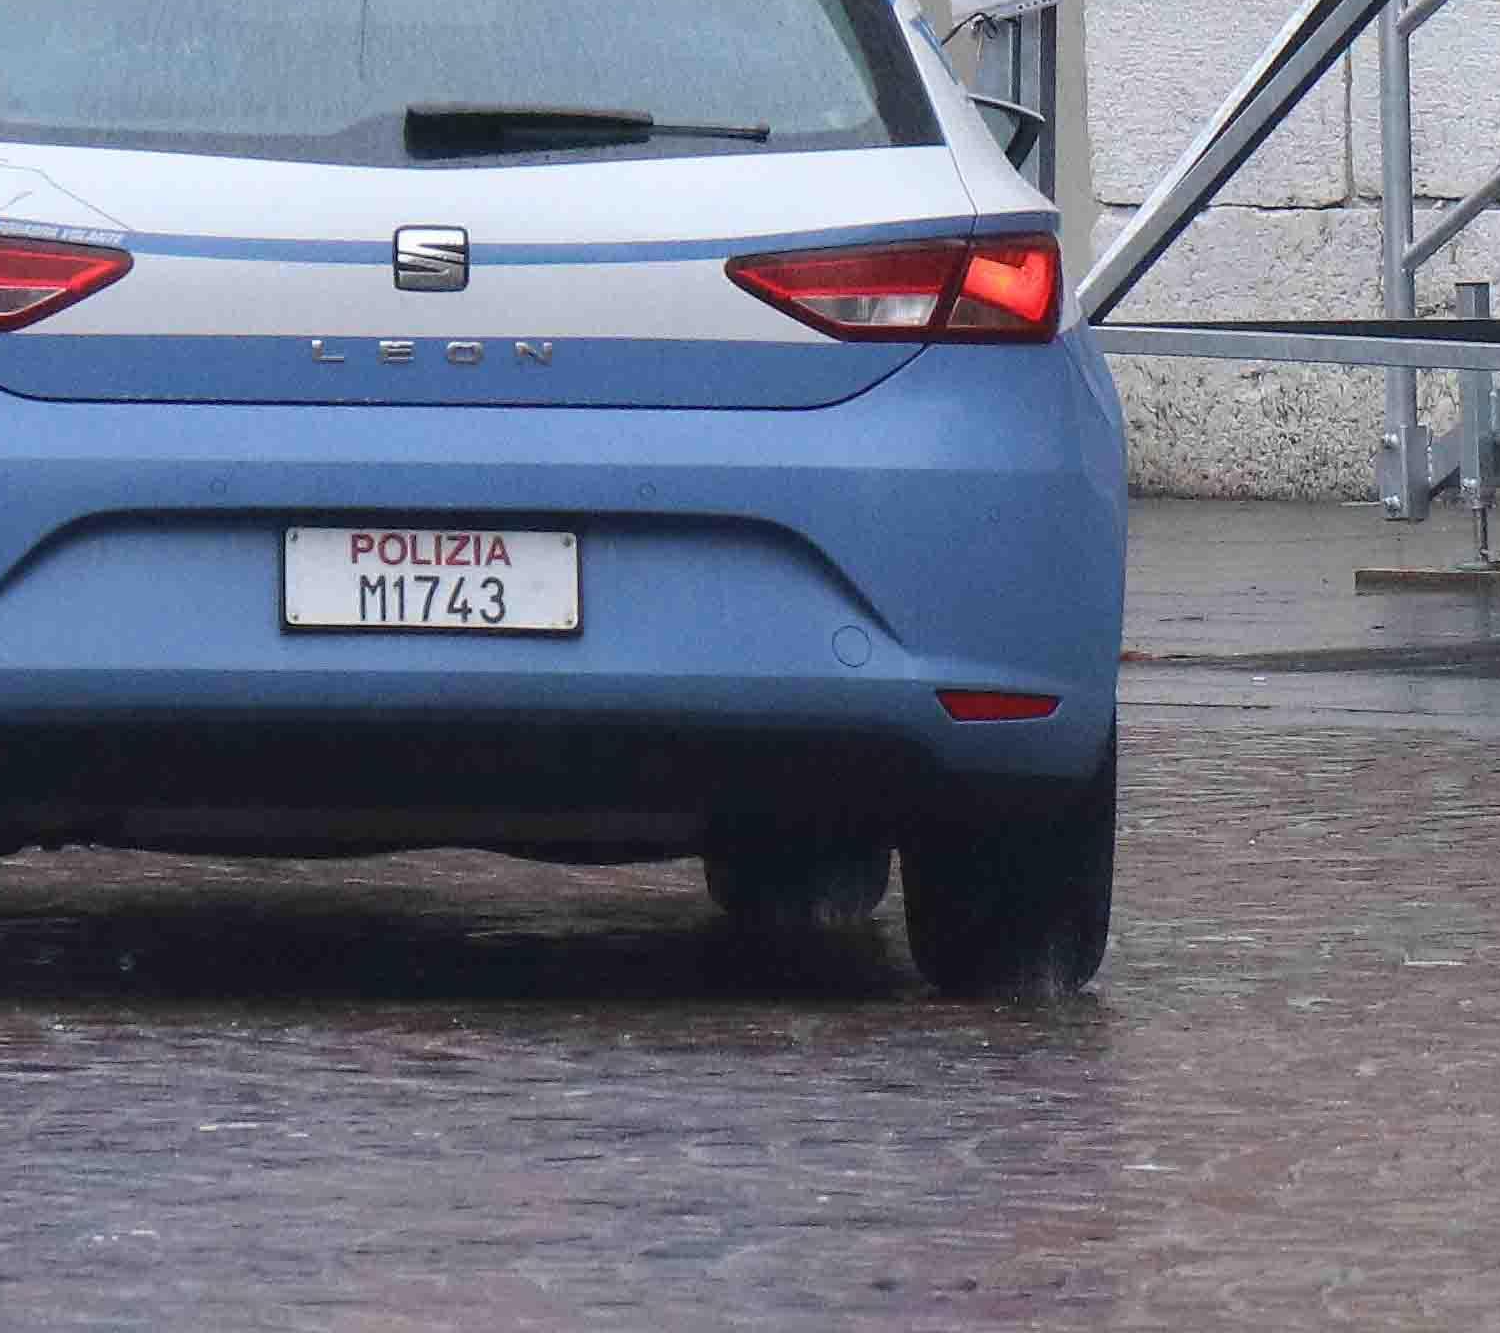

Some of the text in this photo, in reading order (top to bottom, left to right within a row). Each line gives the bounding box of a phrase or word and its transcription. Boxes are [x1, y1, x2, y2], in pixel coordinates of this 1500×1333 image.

[311, 339, 553, 367] LEON
[350, 532, 512, 566] POLIZIA
[358, 574, 508, 624] M1743
